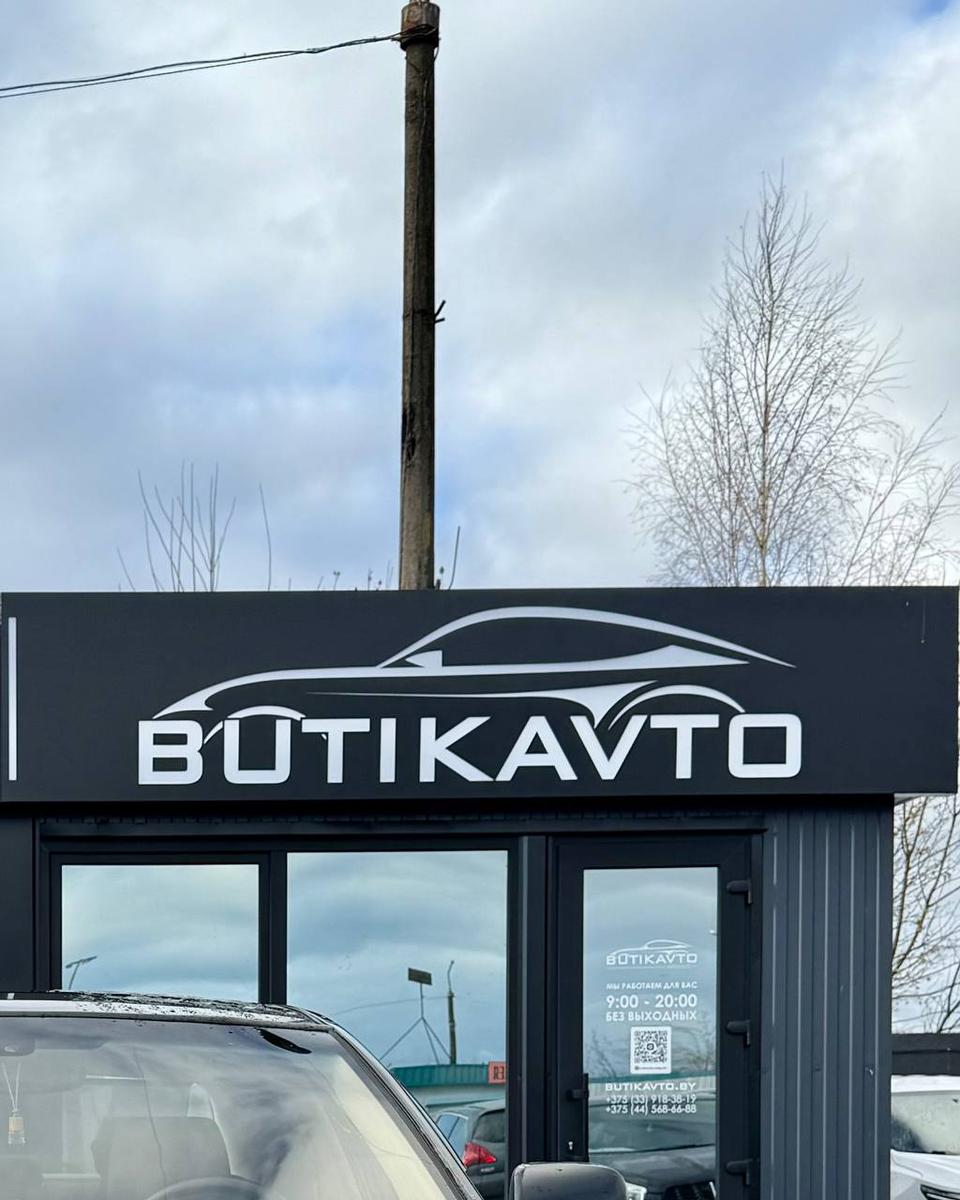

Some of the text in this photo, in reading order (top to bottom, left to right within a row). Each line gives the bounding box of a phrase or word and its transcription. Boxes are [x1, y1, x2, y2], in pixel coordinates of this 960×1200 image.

[137, 713, 803, 786] BUTIKAVTO
[606, 953, 697, 966] BUTIKAVTO
[663, 982, 680, 990] ДЛЯ
[681, 981, 698, 989] ВАС
[606, 994, 639, 1009] 9:00
[654, 993, 698, 1008] 20:00
[605, 1010, 697, 1022] БЕЗ ВЫХОДНЫХ
[604, 1082, 697, 1091] BUTIKAVTO.BY
[605, 1094, 697, 1105] +375 (33) 918-38-19
[605, 1104, 697, 1116] +375 (44) 568-66-88
